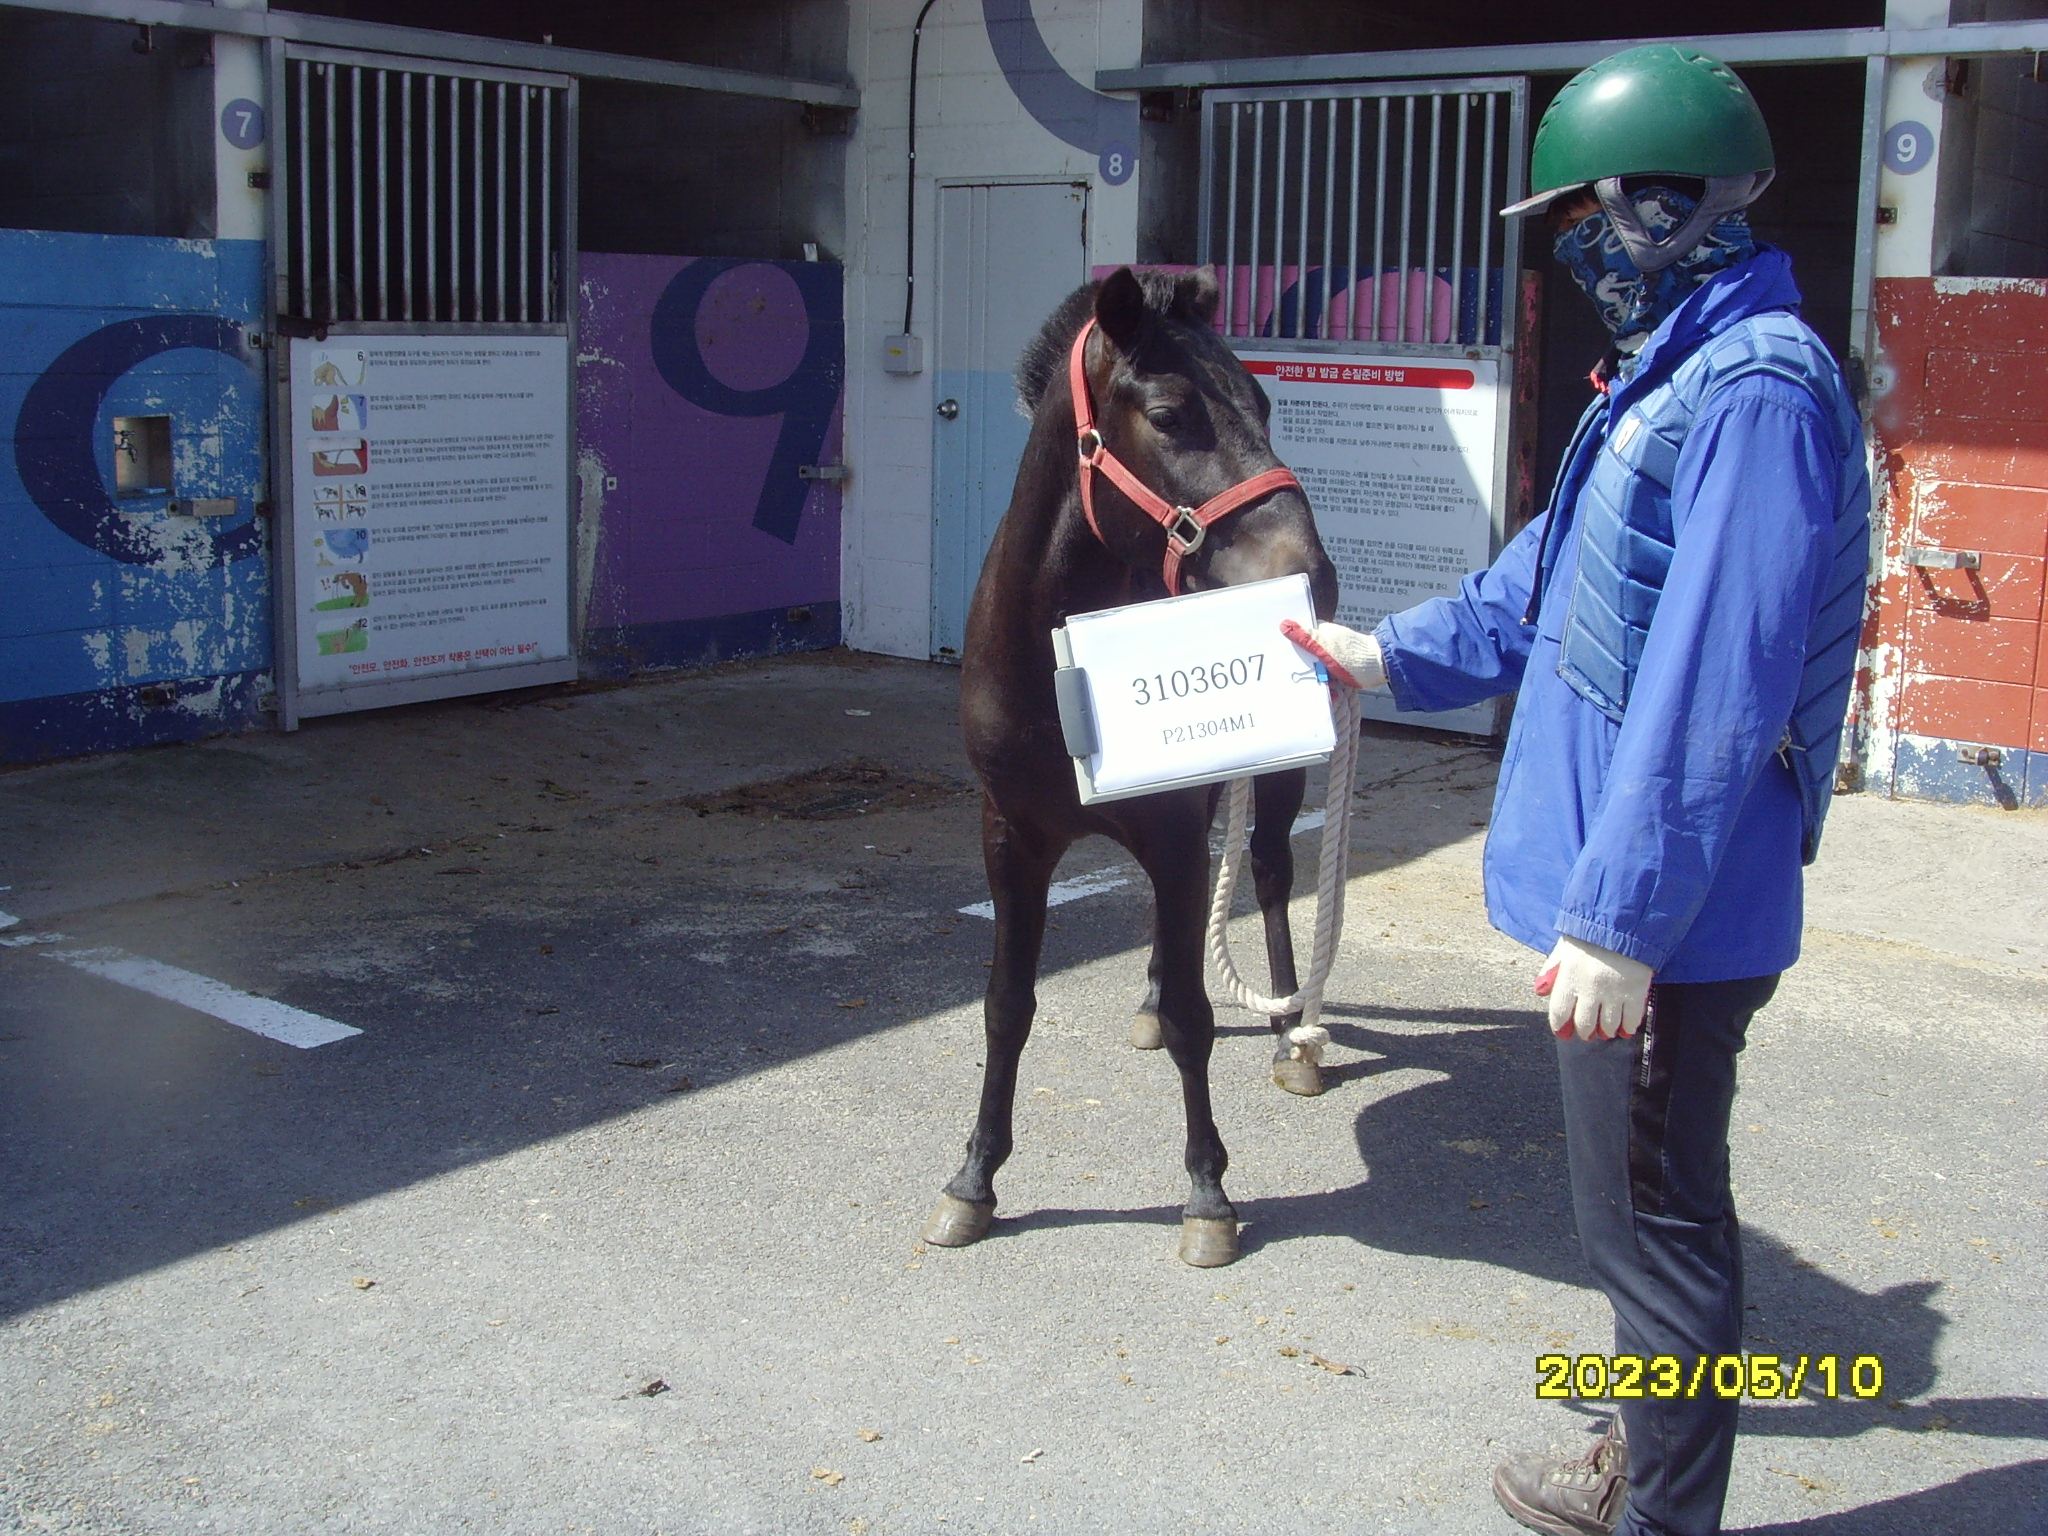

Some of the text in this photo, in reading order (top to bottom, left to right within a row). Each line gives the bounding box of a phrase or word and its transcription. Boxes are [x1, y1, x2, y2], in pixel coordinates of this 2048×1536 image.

[235, 110, 252, 139] 7
[1896, 133, 1918, 163] 9
[1108, 153, 1123, 177] 8
[1276, 365, 1404, 382] 안전한 말 발굽 손질준비 방법
[355, 530, 367, 540] 10
[357, 618, 368, 629] 12
[414, 654, 445, 666] 안전조끼
[449, 650, 471, 662] 착용은
[475, 648, 497, 659] 선택이
[500, 646, 514, 655] 아닌
[1132, 653, 1265, 705] 3103607
[1162, 712, 1255, 745] P21304M1
